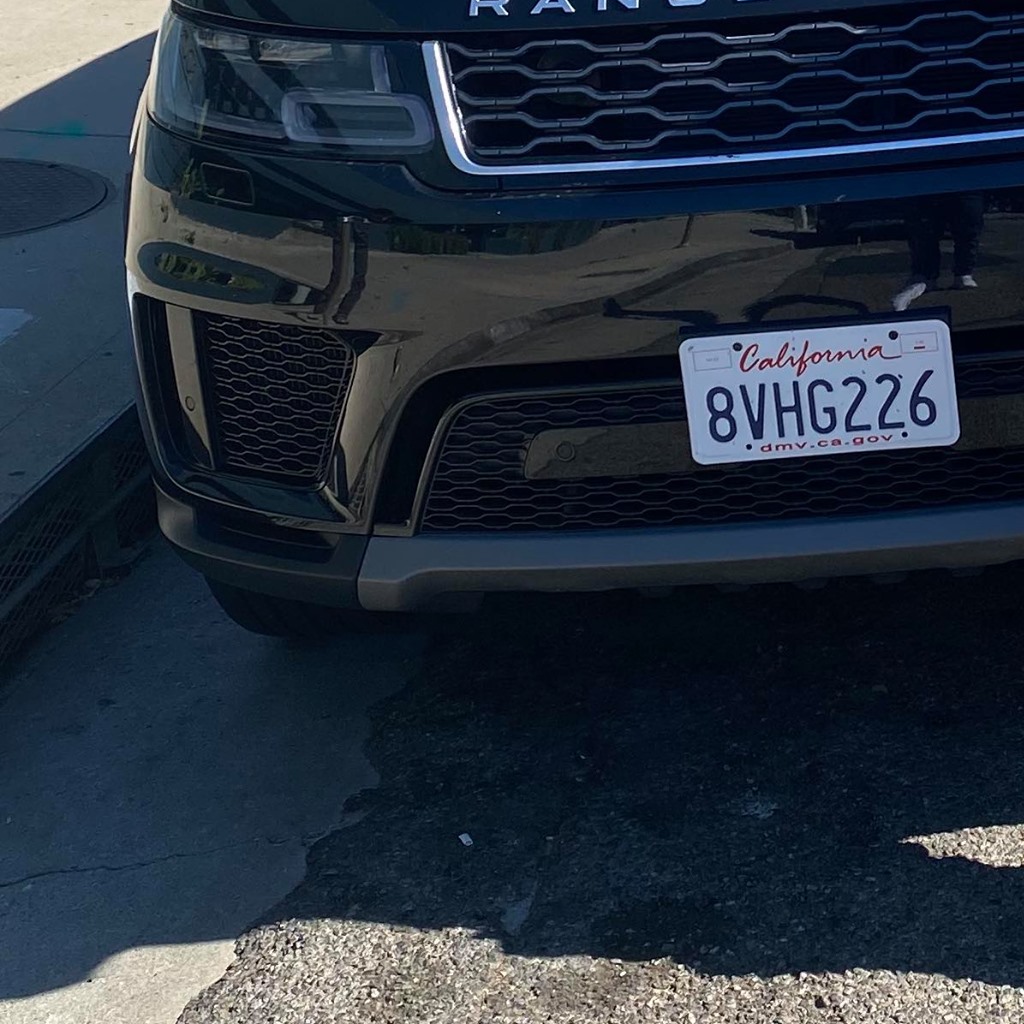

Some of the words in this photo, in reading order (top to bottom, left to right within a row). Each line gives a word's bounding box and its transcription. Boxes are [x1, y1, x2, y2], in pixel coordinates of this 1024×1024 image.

[739, 340, 902, 377] California
[706, 370, 938, 443] 8VHG226
[760, 433, 893, 453] dmv.ca.gov
